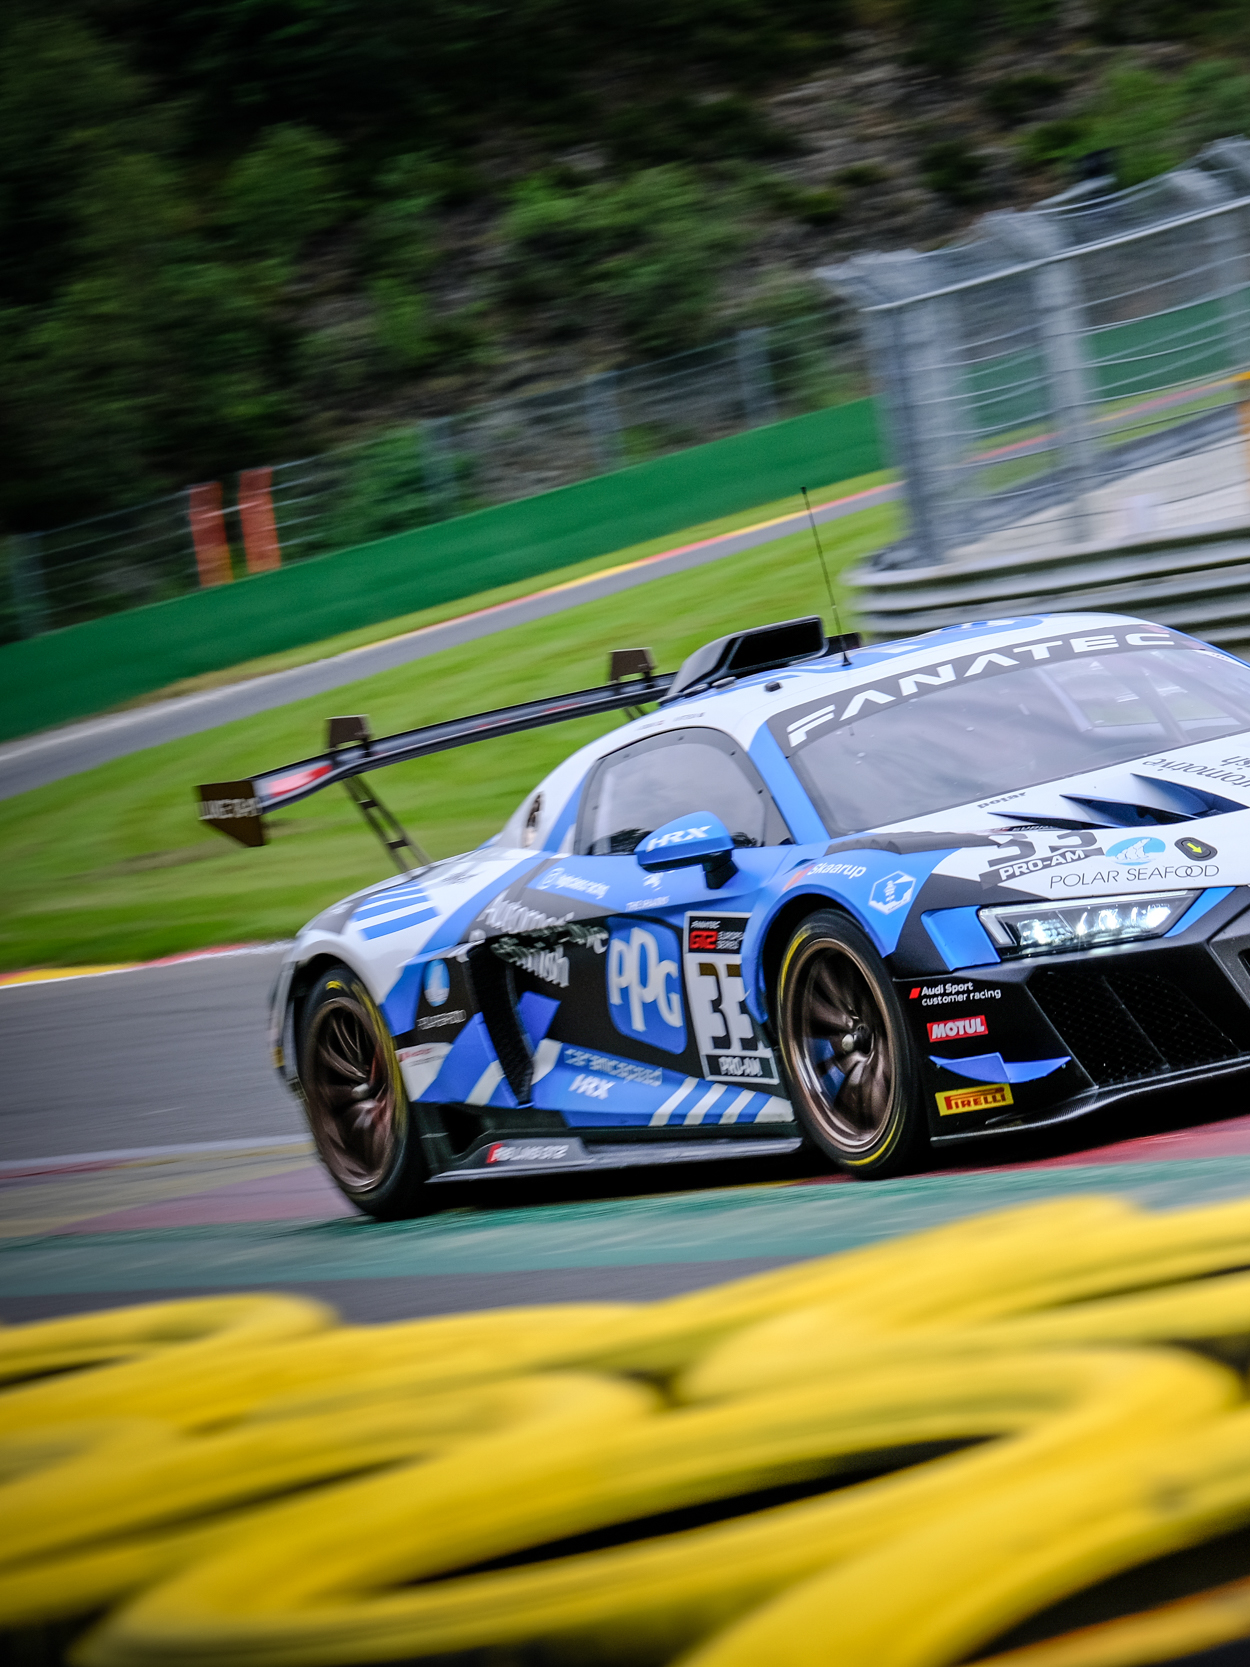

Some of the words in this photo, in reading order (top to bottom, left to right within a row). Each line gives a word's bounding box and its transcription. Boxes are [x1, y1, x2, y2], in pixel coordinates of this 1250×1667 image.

[786, 632, 1175, 748] FANATEC
[645, 825, 713, 853] HRX
[806, 862, 867, 880] Skaarup
[999, 849, 1086, 881] PRO-AM
[1049, 869, 1120, 889] POLAR
[1126, 864, 1220, 882] SEAFOOD
[608, 926, 684, 1033] PPG
[921, 986, 944, 997] Audi
[945, 981, 974, 994] Sport
[922, 994, 967, 1006] customer
[970, 988, 1002, 1001] racing
[931, 1017, 985, 1040] MOTUL
[944, 1086, 1007, 1111] PIRELLI
